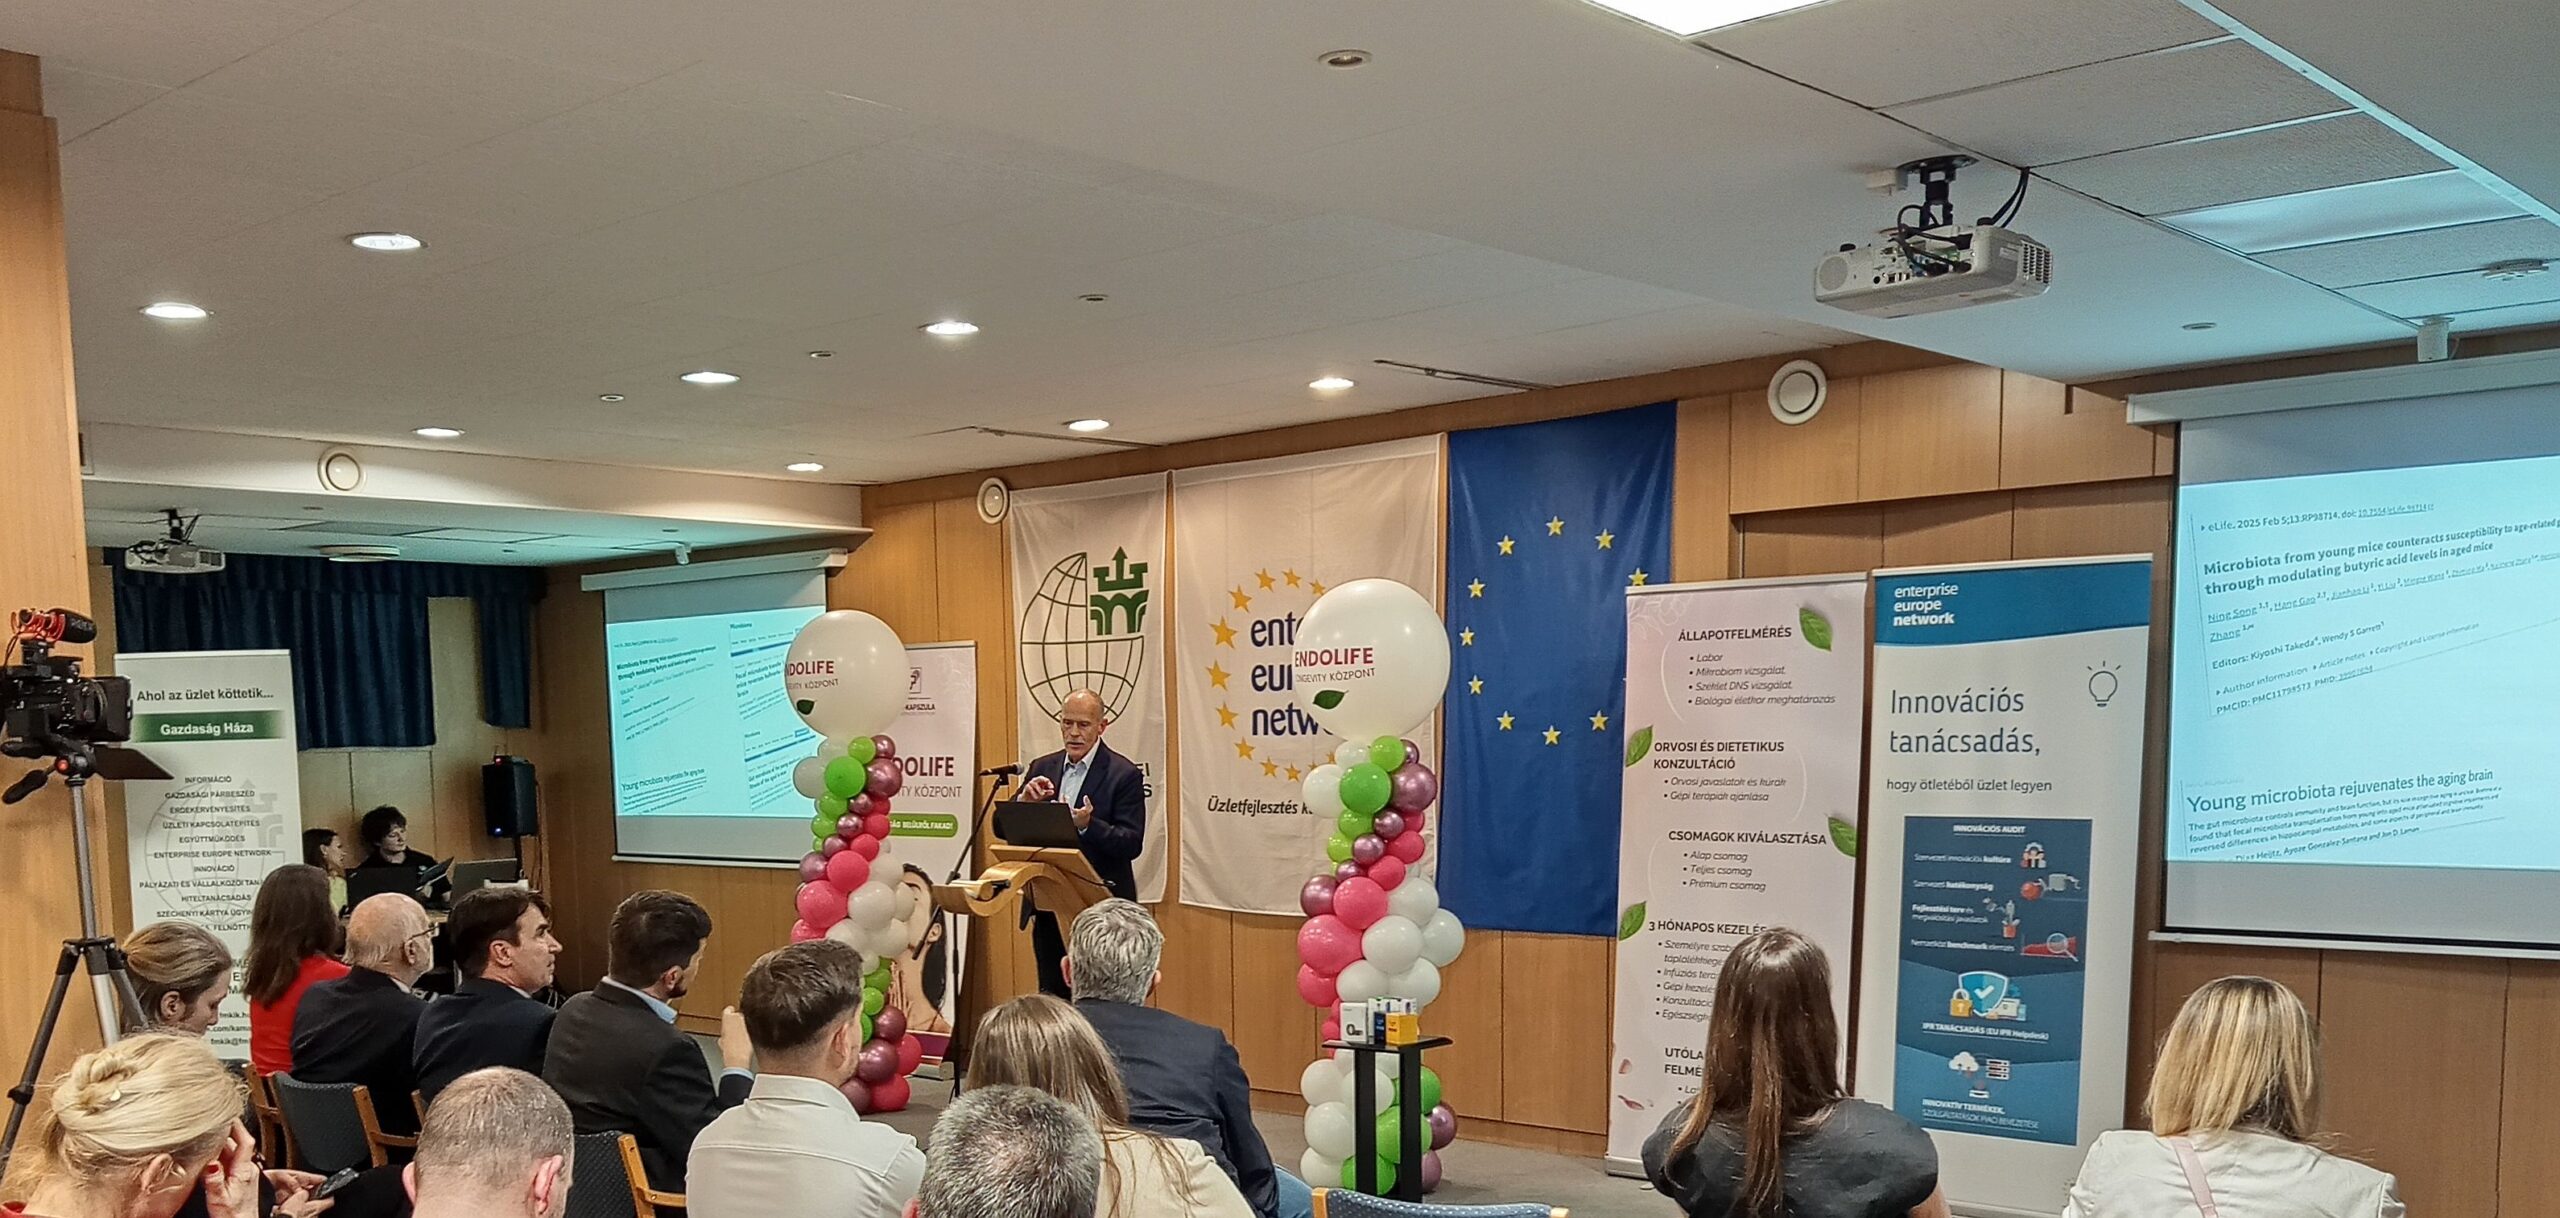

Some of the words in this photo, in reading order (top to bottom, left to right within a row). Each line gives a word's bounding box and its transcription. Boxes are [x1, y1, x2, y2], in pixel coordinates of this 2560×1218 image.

[2237, 519, 2261, 528] 2025
[2263, 517, 2280, 526] Feb
[2204, 557, 2281, 575] Microbiota
[2285, 552, 2315, 564] from
[2318, 546, 2355, 561] young
[2357, 541, 2383, 553] mice
[2386, 533, 2444, 549] counteracts
[2446, 526, 2503, 542] susceptibility
[2504, 524, 2513, 533] to
[2514, 518, 2555, 532] age-related
[2204, 576, 2264, 595] through
[2268, 565, 2341, 584] modulating
[2344, 557, 2384, 573] butyric
[2386, 554, 2407, 566] acid
[2410, 549, 2438, 562] levels
[2439, 548, 2449, 557] in
[2450, 544, 2472, 557] aged
[2473, 542, 2493, 552] mice
[1895, 583, 1959, 599] enterprise
[1894, 599, 1941, 613] europe
[1893, 612, 1954, 626] network
[1678, 627, 1792, 641] ÁLLAPOTFELMÉRÉS
[2212, 655, 2249, 670] Editors:
[2251, 645, 2283, 661] Kiyoshi
[2322, 631, 2348, 644] Wendy
[1295, 648, 1373, 667] ENDOLIFE
[1696, 653, 1723, 662] Labor
[1330, 668, 1375, 681] KÖZPONT
[2223, 680, 2255, 694] Author
[2257, 666, 2308, 686] information
[805, 679, 839, 689] KÖZPONT
[1729, 681, 1749, 690] DNS
[137, 690, 164, 701] Ahol
[169, 692, 182, 700] az
[186, 689, 215, 700] üzlet
[1891, 687, 2024, 714] Innovációs
[2217, 699, 2250, 714] PMCID:
[1252, 702, 1333, 736] netw
[160, 723, 221, 736] Gazdaság
[224, 723, 254, 734] Háza
[1654, 742, 1697, 752] ORVOSI
[1700, 739, 1714, 751] ÉS
[1717, 742, 1784, 751] DIETETIKUS
[1890, 727, 2040, 756] tanácsadás,
[1654, 756, 1735, 769] KONZULTÁCIÓ
[185, 775, 232, 783] INFORMÁCIÓ
[1671, 777, 1698, 786] Orvosi
[1887, 779, 1916, 792] hogy
[1920, 778, 1974, 790] ötletéből
[1977, 779, 2007, 791] üzlet
[2011, 780, 2052, 793] legyen
[165, 791, 208, 799] GAZDASÁGI
[915, 784, 961, 797] KÖZPONT
[2187, 795, 2246, 812] Young
[2251, 785, 2335, 805] microbiota
[2340, 776, 2413, 797] rejuvenates
[2417, 774, 2435, 787] the
[2437, 772, 2466, 787] aging
[2468, 769, 2493, 782] brain
[1208, 795, 1297, 817] Üzletfejlesztés
[163, 821, 188, 829] ÜZLETI
[2189, 823, 2205, 831] The
[2207, 821, 2220, 830] gut
[2222, 816, 2263, 826] microbiota
[1669, 831, 1735, 842] CSOMAGOK
[1737, 831, 1826, 844] KIVÁLASZTÁSA
[2190, 834, 2213, 842] found
[2216, 830, 2232, 839] that
[2234, 825, 2252, 835] fecal
[2254, 822, 2292, 832] microbiota
[2190, 841, 2225, 854] reversed
[2227, 837, 2268, 847] differences
[154, 851, 200, 859] ENTERPRISE
[202, 850, 231, 858] EUROPE
[1690, 851, 1711, 861] Alap
[1713, 853, 1748, 863] csomag
[194, 864, 235, 872] INNOVÁCIÓ
[1691, 865, 1715, 875] Teljes
[1717, 867, 1752, 877] csomag
[139, 880, 179, 888] PÁLYÁZATI
[1730, 883, 1766, 892] csomag
[157, 909, 198, 918] SZÉCHENYI
[200, 908, 229, 917] KÁRTYA
[1649, 922, 1655, 931] 3
[1658, 919, 1714, 933] HÓNAPOS
[1665, 1046, 1704, 1060] UTÓLA
[1664, 1064, 1702, 1077] FELMÉ
